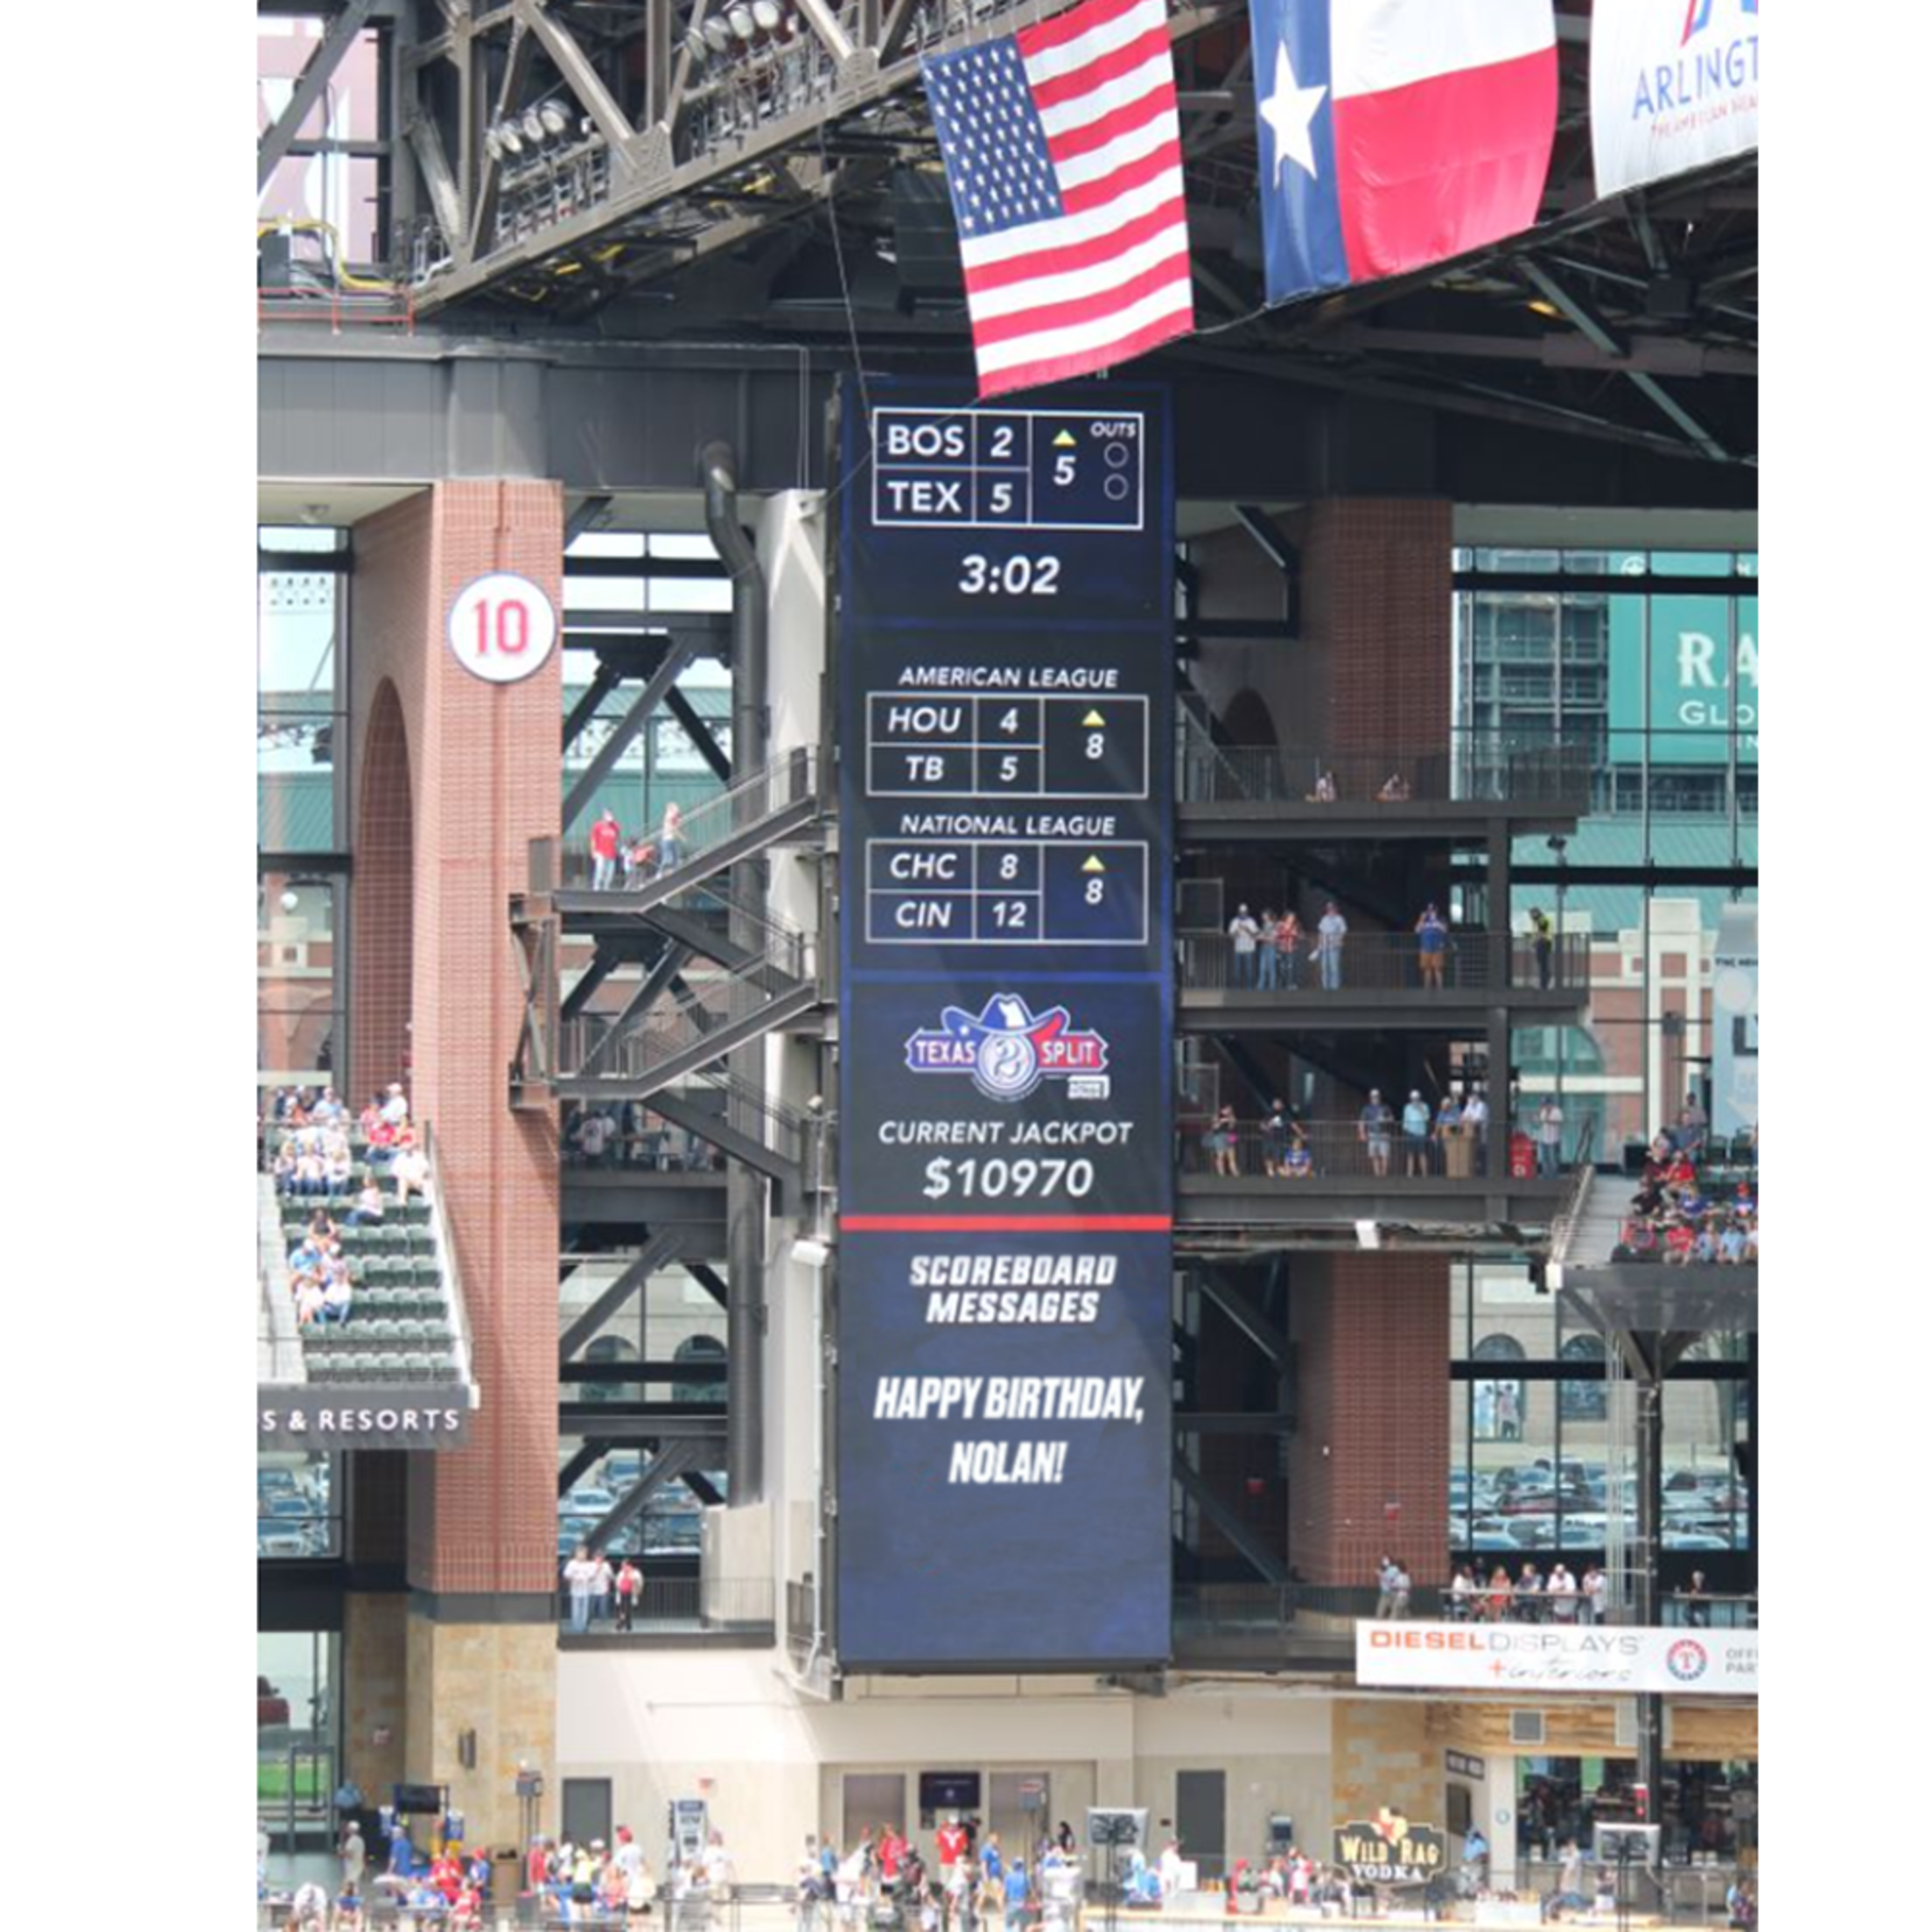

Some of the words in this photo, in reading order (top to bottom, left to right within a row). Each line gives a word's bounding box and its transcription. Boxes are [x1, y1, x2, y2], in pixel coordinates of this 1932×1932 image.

[1632, 35, 1761, 120] ARLINGT
[887, 424, 964, 457] BOS
[990, 426, 1013, 458] 2
[1090, 422, 1137, 438] OUTS
[1053, 455, 1077, 486] 5
[887, 481, 962, 513] TEX
[990, 483, 1012, 514] 5
[959, 555, 1060, 594] 3:02
[473, 598, 528, 654] 10
[899, 667, 1021, 687] AMERICAN
[1028, 668, 1118, 689] LEAGUE
[888, 706, 962, 733] HOU
[999, 708, 1018, 733] 4
[1085, 732, 1104, 760] 8
[906, 755, 944, 781] TB
[999, 756, 1018, 781] 5
[900, 815, 1018, 835] NATIONAL
[1026, 816, 1116, 836] LEAGUE
[890, 852, 957, 879] CHC
[999, 853, 1018, 879] 8
[1085, 878, 1103, 905] 8
[895, 901, 952, 928] CIN
[993, 901, 1027, 928] 12
[915, 1040, 977, 1065] TEXAS
[1040, 1040, 1096, 1065] SPLIT
[878, 1120, 1004, 1144] CURRENT
[1008, 1121, 1134, 1144] JACKPOT
[922, 1156, 1095, 1200] $10970
[909, 1255, 1117, 1286] SCOREBOARD
[925, 1291, 1100, 1323] MESSAGES
[873, 1376, 984, 1419] HAPPY
[982, 1376, 1144, 1424] BIRTHDAY,
[288, 1410, 307, 1431] &
[318, 1409, 458, 1431] RESORTS
[948, 1440, 1068, 1484] NOLAN!
[1352, 1864, 1423, 1880] VODKA
